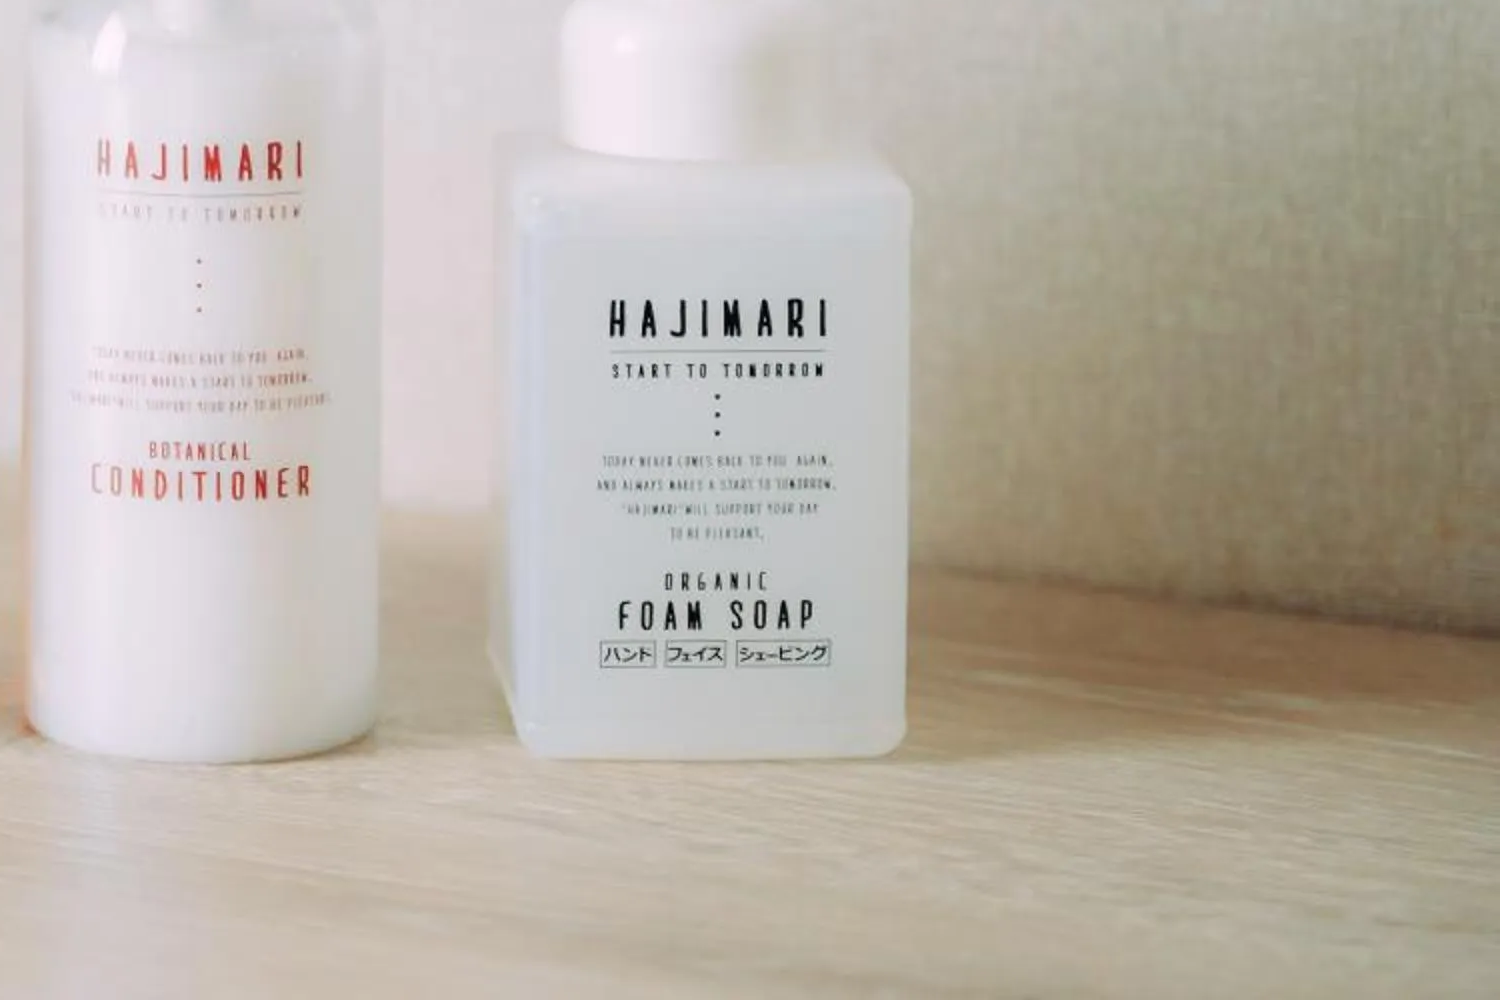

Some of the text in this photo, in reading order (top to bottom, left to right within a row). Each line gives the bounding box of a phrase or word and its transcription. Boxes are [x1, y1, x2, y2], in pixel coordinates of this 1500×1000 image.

[97, 138, 303, 182] HAJIMARI
[609, 298, 827, 338] HAJIMARI
[612, 362, 824, 379] START TO TOMORROW
[149, 441, 251, 462] BOTANICAL
[91, 463, 310, 502] CONDITIONER
[664, 571, 767, 591] ORGANIC
[618, 600, 813, 631] FOAM SOAP
[603, 645, 829, 663] ハンド フェイス シェービング
